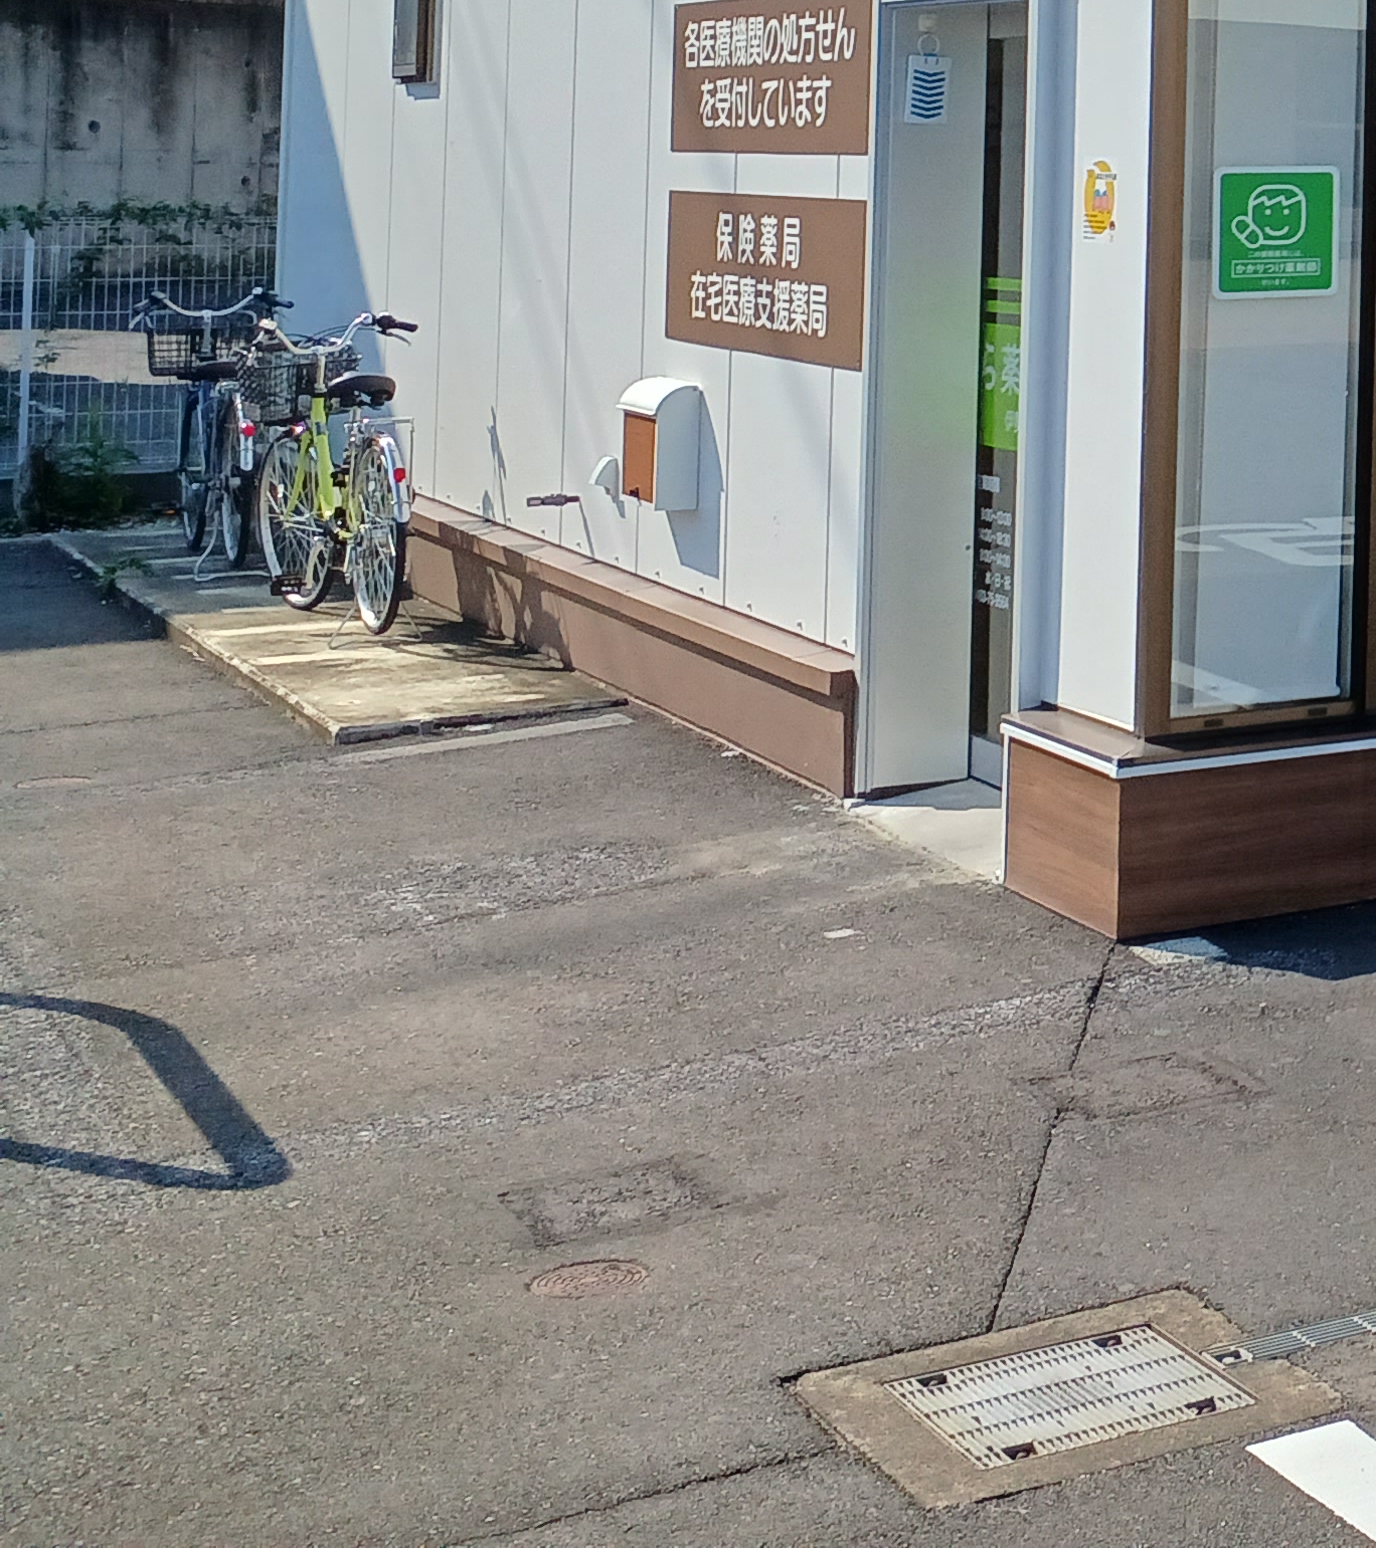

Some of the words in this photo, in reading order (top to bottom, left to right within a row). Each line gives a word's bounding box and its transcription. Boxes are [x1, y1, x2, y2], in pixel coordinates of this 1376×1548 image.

[684, 7, 856, 68] 各医療機関の処方せん
[700, 74, 832, 128] を受付しています
[716, 212, 801, 269] 保険薬局
[690, 270, 827, 338] 在宅医療支援薬局
